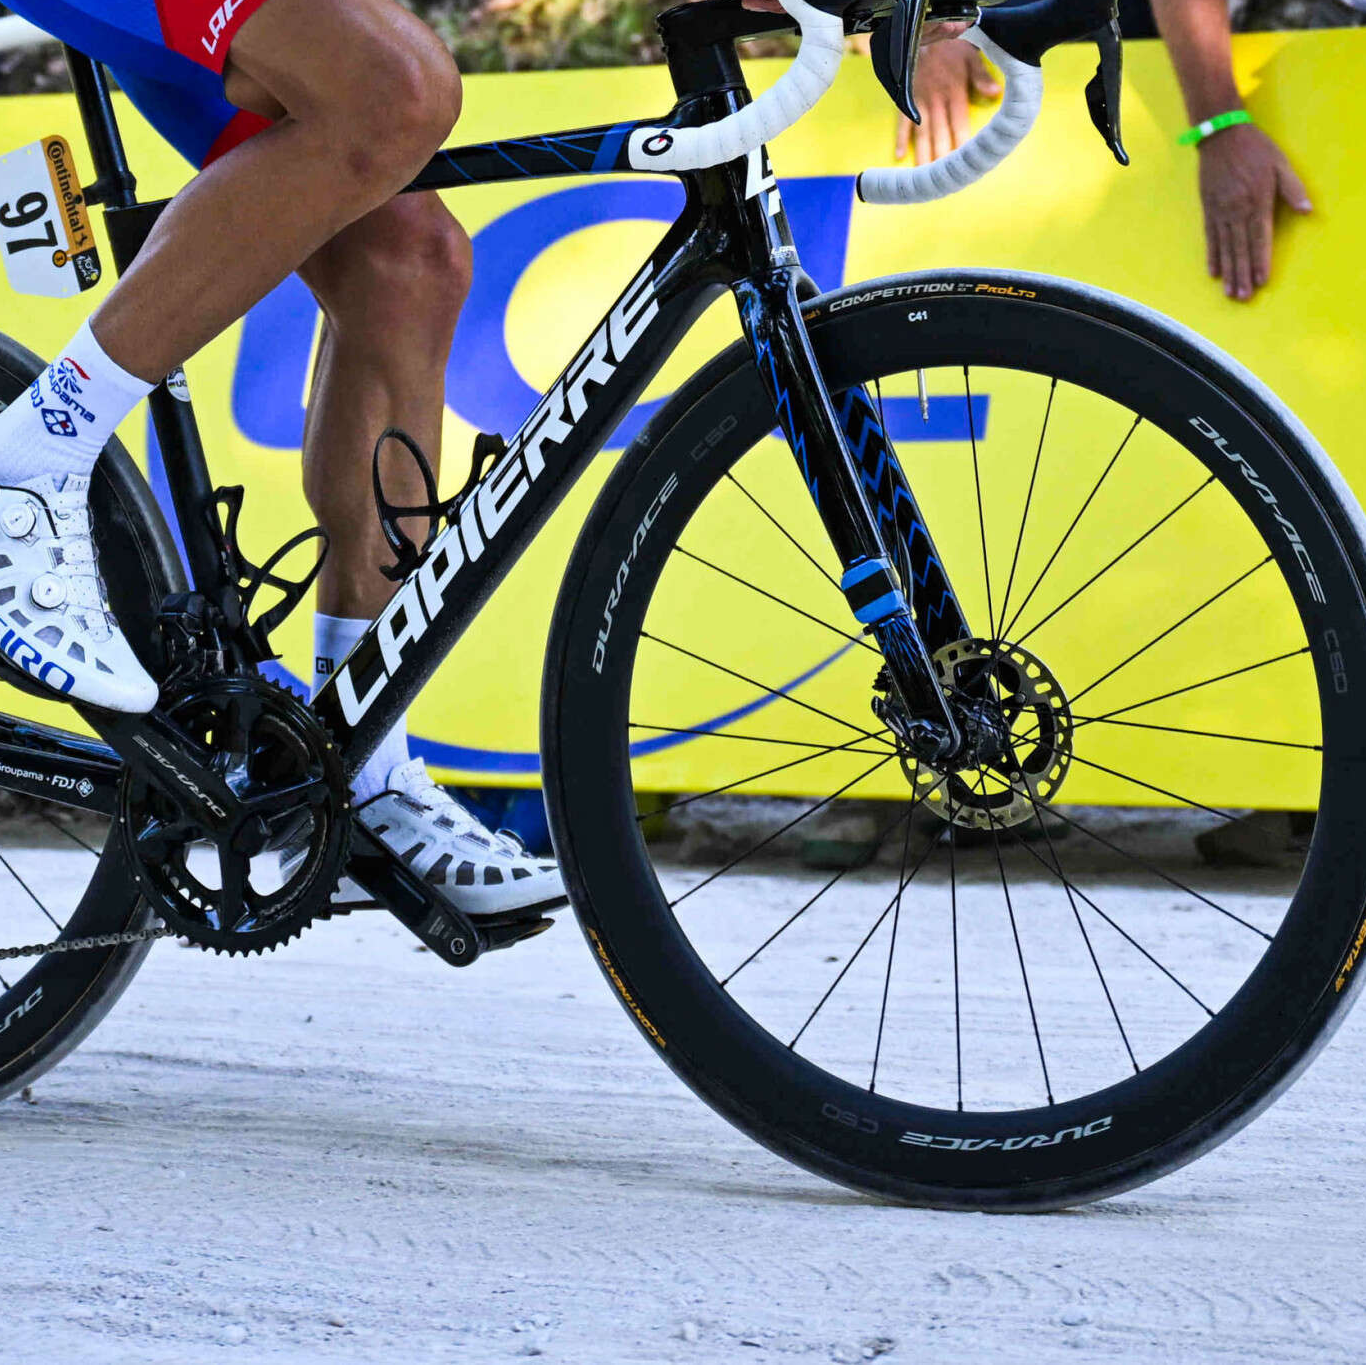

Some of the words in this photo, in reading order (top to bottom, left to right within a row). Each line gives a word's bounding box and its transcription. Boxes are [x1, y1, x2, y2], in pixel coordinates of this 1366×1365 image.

[46, 140, 85, 234] Continental
[828, 283, 955, 313] COMPETITION
[907, 310, 929, 323] C41
[334, 260, 662, 727] LAPIERRE
[1188, 415, 1327, 605] DURA-ACE
[592, 471, 680, 675] DURA-ACE
[51, 775, 76, 790] FDJ
[132, 734, 227, 819] DURA-ACE
[898, 1115, 1114, 1152] DURA-ACE
